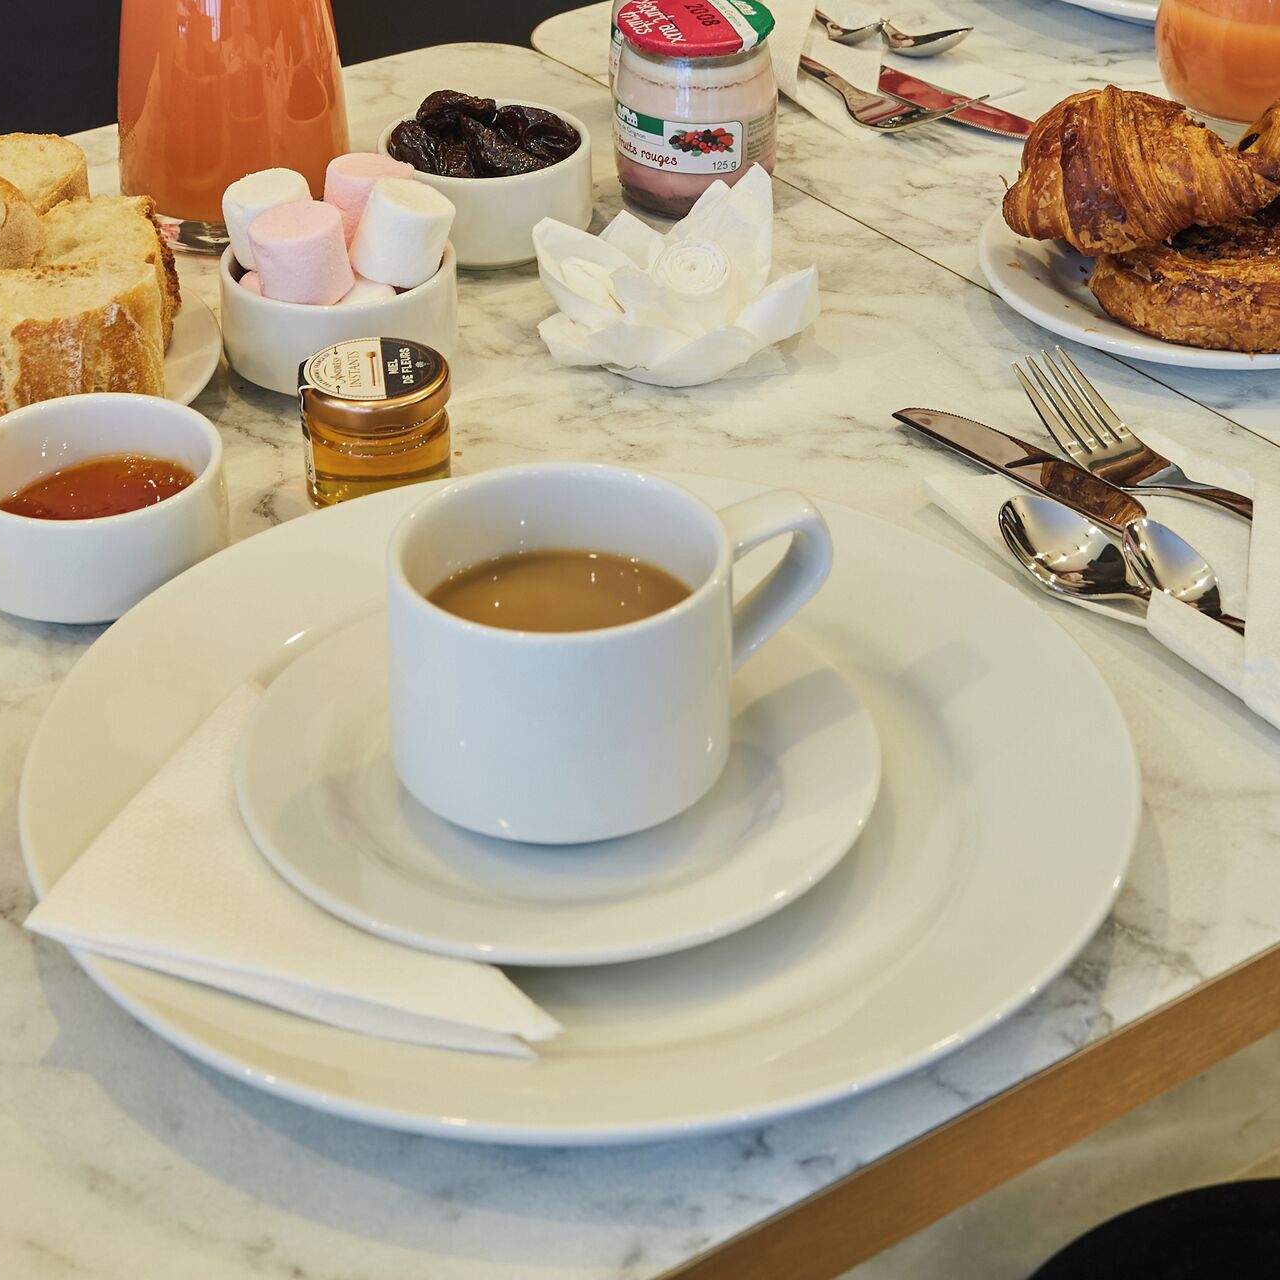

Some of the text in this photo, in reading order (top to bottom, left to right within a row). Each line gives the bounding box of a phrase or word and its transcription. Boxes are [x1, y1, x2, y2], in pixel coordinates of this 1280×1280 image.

[620, 10, 654, 35] fruits
[683, 3, 721, 27] 2008
[658, 22, 687, 44] aux
[618, 134, 678, 167] fruits rouges
[712, 161, 737, 171] 125 g
[346, 350, 362, 388] INSTANTS
[387, 358, 399, 375] MIEL
[399, 347, 414, 385] DE FLEURS
